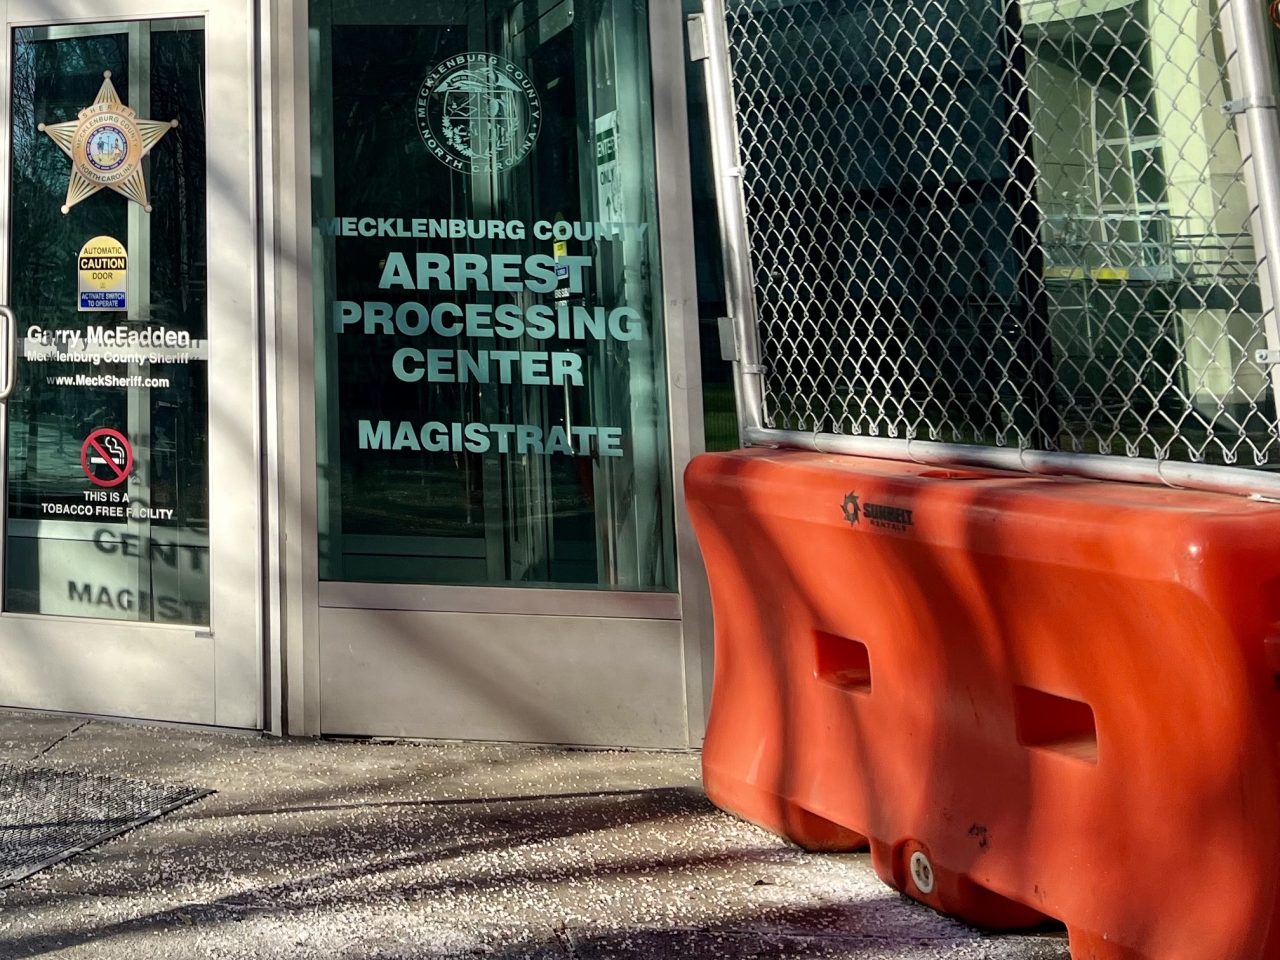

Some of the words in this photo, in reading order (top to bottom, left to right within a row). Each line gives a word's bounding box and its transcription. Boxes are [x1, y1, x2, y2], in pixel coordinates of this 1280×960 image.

[418, 54, 497, 118] MECKLENBURG
[505, 64, 540, 119] COUNTY
[82, 105, 134, 118] SHERIFF
[76, 115, 118, 149] MECKLENBURG
[120, 120, 138, 148] COUNTY
[422, 129, 463, 169] NORTH
[472, 132, 537, 172] CAROLINA
[80, 163, 100, 181] NORTH
[101, 163, 133, 182] CAROLINA
[320, 217, 526, 240] MECKLENBURG
[533, 220, 649, 242] COUNTY
[83, 246, 122, 255] AUTOMATIC
[80, 257, 125, 269] CAUTION
[378, 251, 592, 294] ARREST
[92, 271, 114, 280] DOOR
[81, 292, 105, 300] ACTIVATE
[105, 292, 125, 300] SWITCH
[332, 300, 642, 341] PROCESSING
[26, 325, 81, 345] Garry
[86, 325, 190, 346] McFadden
[26, 350, 101, 365] Mecklenburg
[103, 351, 146, 366] County
[149, 351, 190, 364] Sheriff
[392, 347, 585, 387] CENTER
[46, 374, 170, 388] www.MeckSheriff.com
[358, 419, 624, 457] MAGISTRATE
[83, 490, 107, 502] THIS
[110, 491, 120, 503] IS
[122, 492, 130, 503] A
[41, 503, 93, 516] TOBACCO
[95, 505, 124, 517] FREE
[126, 506, 174, 520] FACILITY
